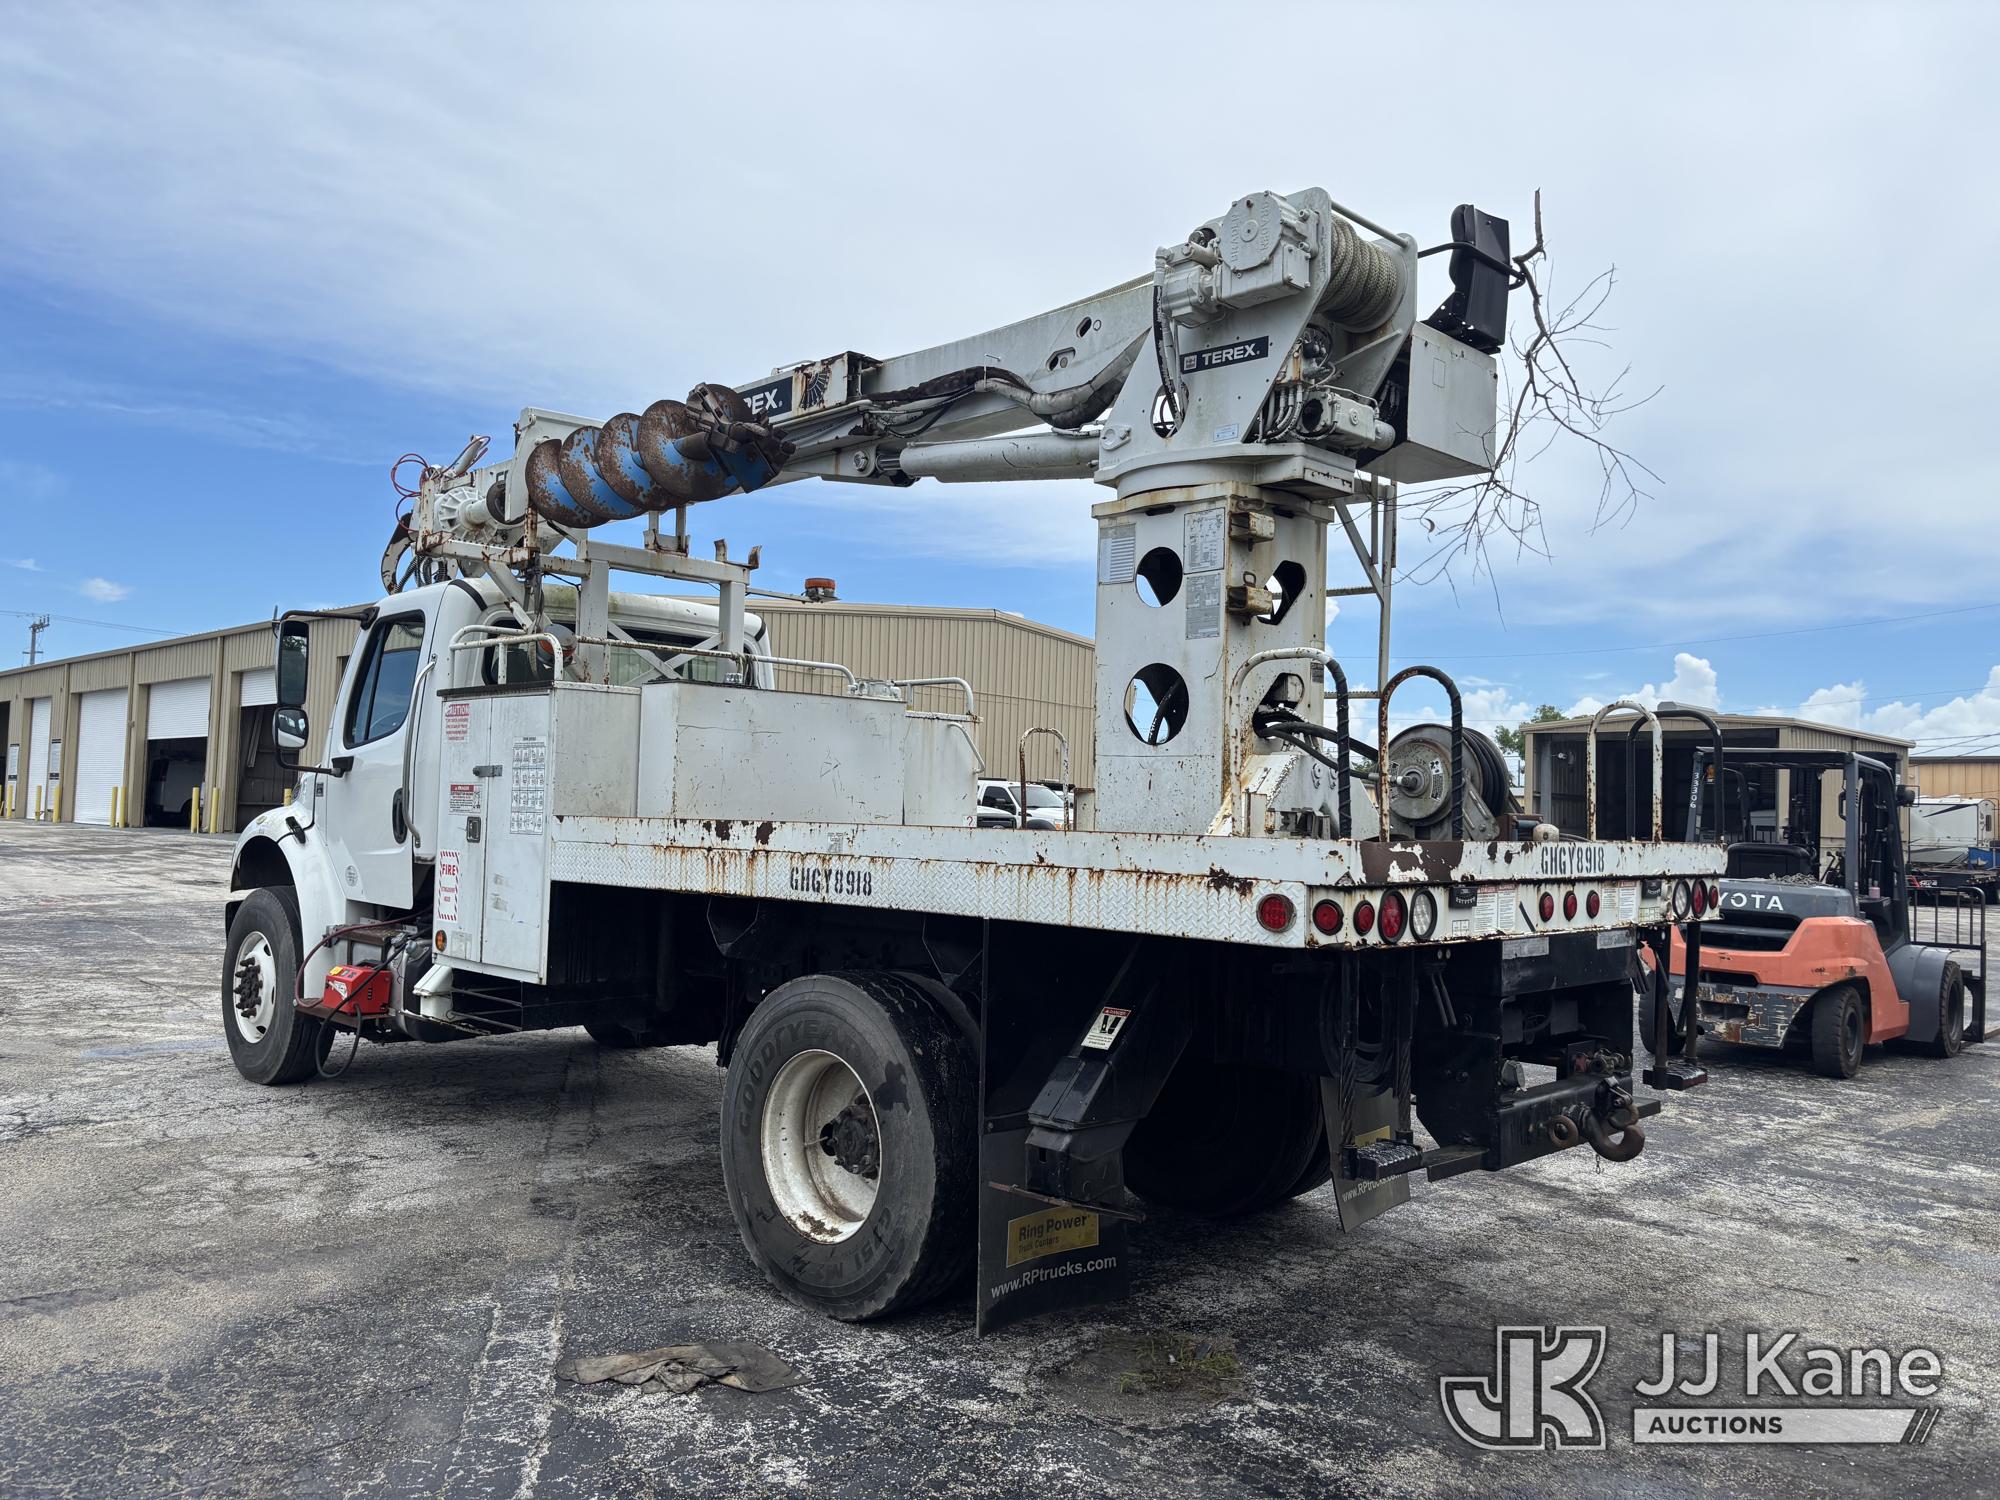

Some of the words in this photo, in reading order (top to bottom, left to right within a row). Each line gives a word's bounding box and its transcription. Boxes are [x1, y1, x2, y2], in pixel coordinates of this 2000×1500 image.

[1201, 343, 1256, 366] TEREX
[743, 388, 778, 415] EX
[1690, 772, 1700, 809] 33306
[442, 863, 456, 876] FIRE
[1541, 846, 1605, 875] GHGY8918
[790, 866, 872, 897] GHGY8918
[1018, 1223, 1044, 1242] Ring
[1046, 1214, 1088, 1233] Power
[991, 1256, 1117, 1299] www.RPtrucks.com
